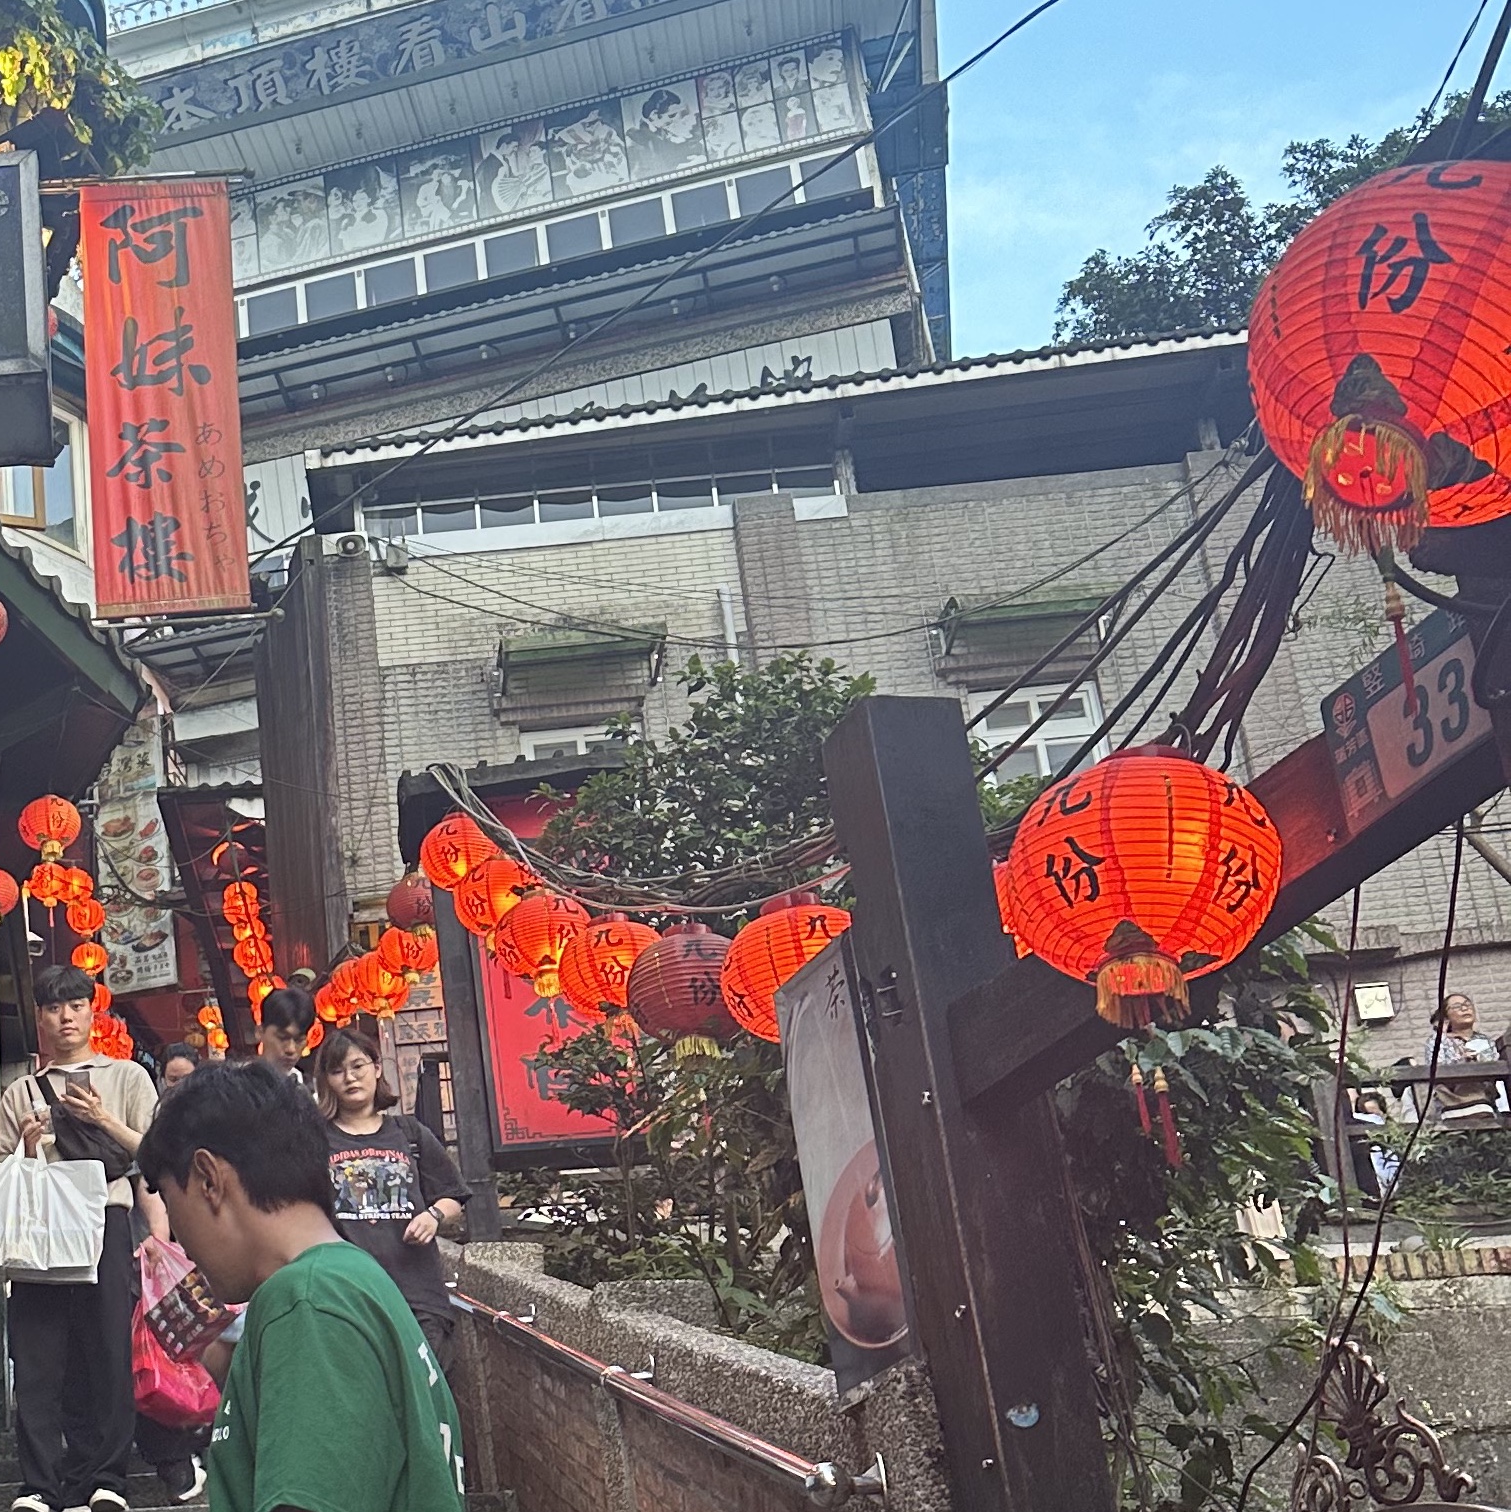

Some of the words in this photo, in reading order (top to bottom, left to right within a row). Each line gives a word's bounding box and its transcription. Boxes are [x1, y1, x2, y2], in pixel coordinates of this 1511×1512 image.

[99, 204, 212, 583] 阿妹茶樓
[1402, 657, 1471, 769] 33
[1038, 776, 1106, 909] 九份
[1211, 781, 1268, 913] 九份
[593, 928, 630, 987] 九份
[682, 939, 720, 1007] 九份
[824, 962, 846, 1020] 茶
